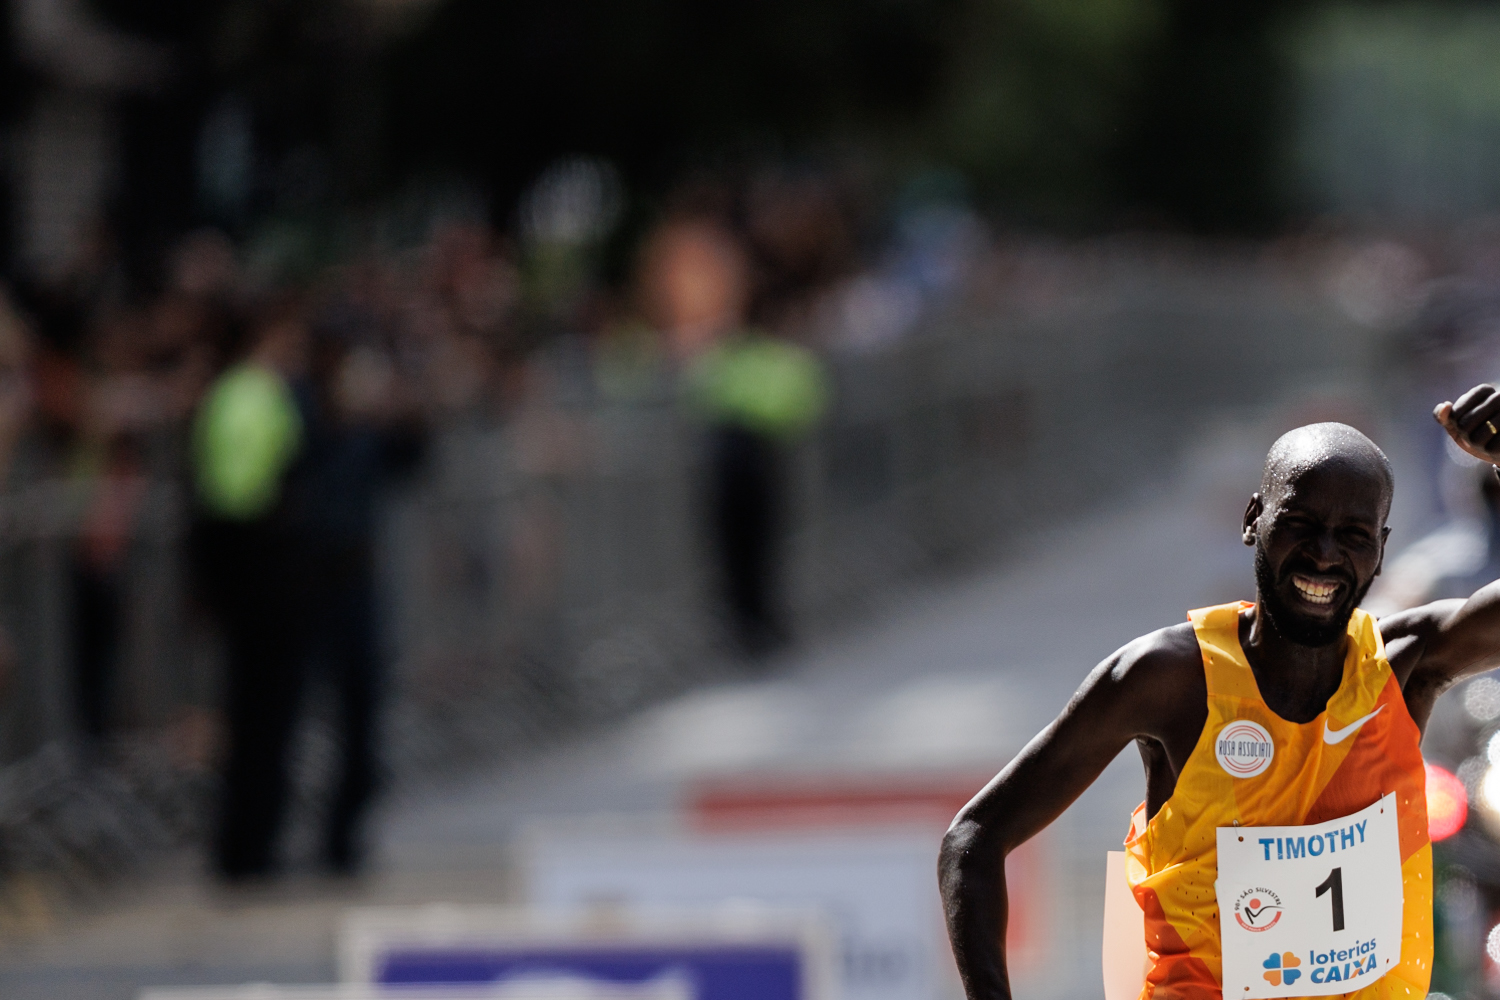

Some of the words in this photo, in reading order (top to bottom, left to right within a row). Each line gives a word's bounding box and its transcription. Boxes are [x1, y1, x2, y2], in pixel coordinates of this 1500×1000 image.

[1218, 740, 1236, 756] ROSA
[1238, 741, 1271, 758] ASSOCIATI
[1258, 818, 1368, 861] TIMOTHY
[1315, 866, 1345, 932] 1
[1309, 938, 1377, 965] loterias
[1310, 953, 1378, 984] CAIXA
